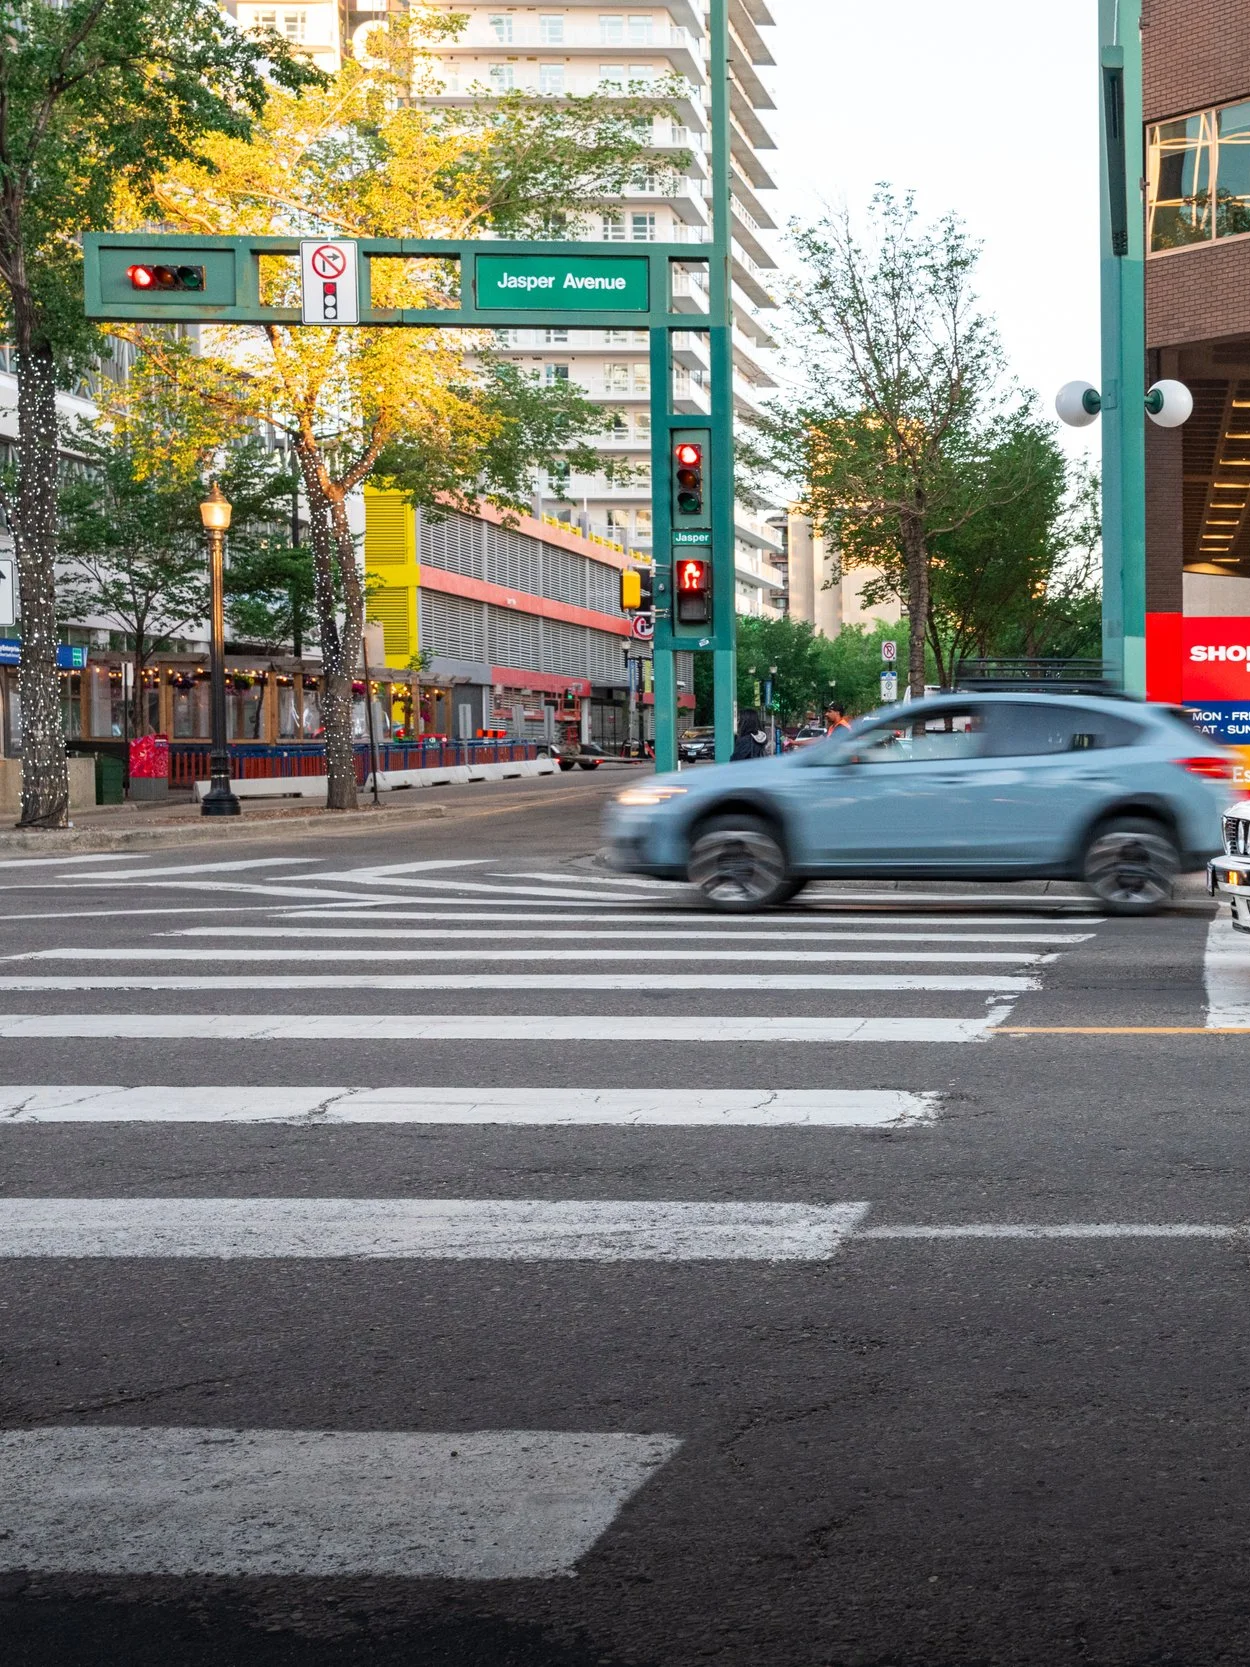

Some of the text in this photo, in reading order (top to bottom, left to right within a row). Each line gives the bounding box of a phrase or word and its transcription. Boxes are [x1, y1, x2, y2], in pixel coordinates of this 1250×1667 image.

[497, 272, 626, 291] Jasper Avenue
[675, 533, 709, 543] Jasper
[1192, 711, 1222, 721] MON
